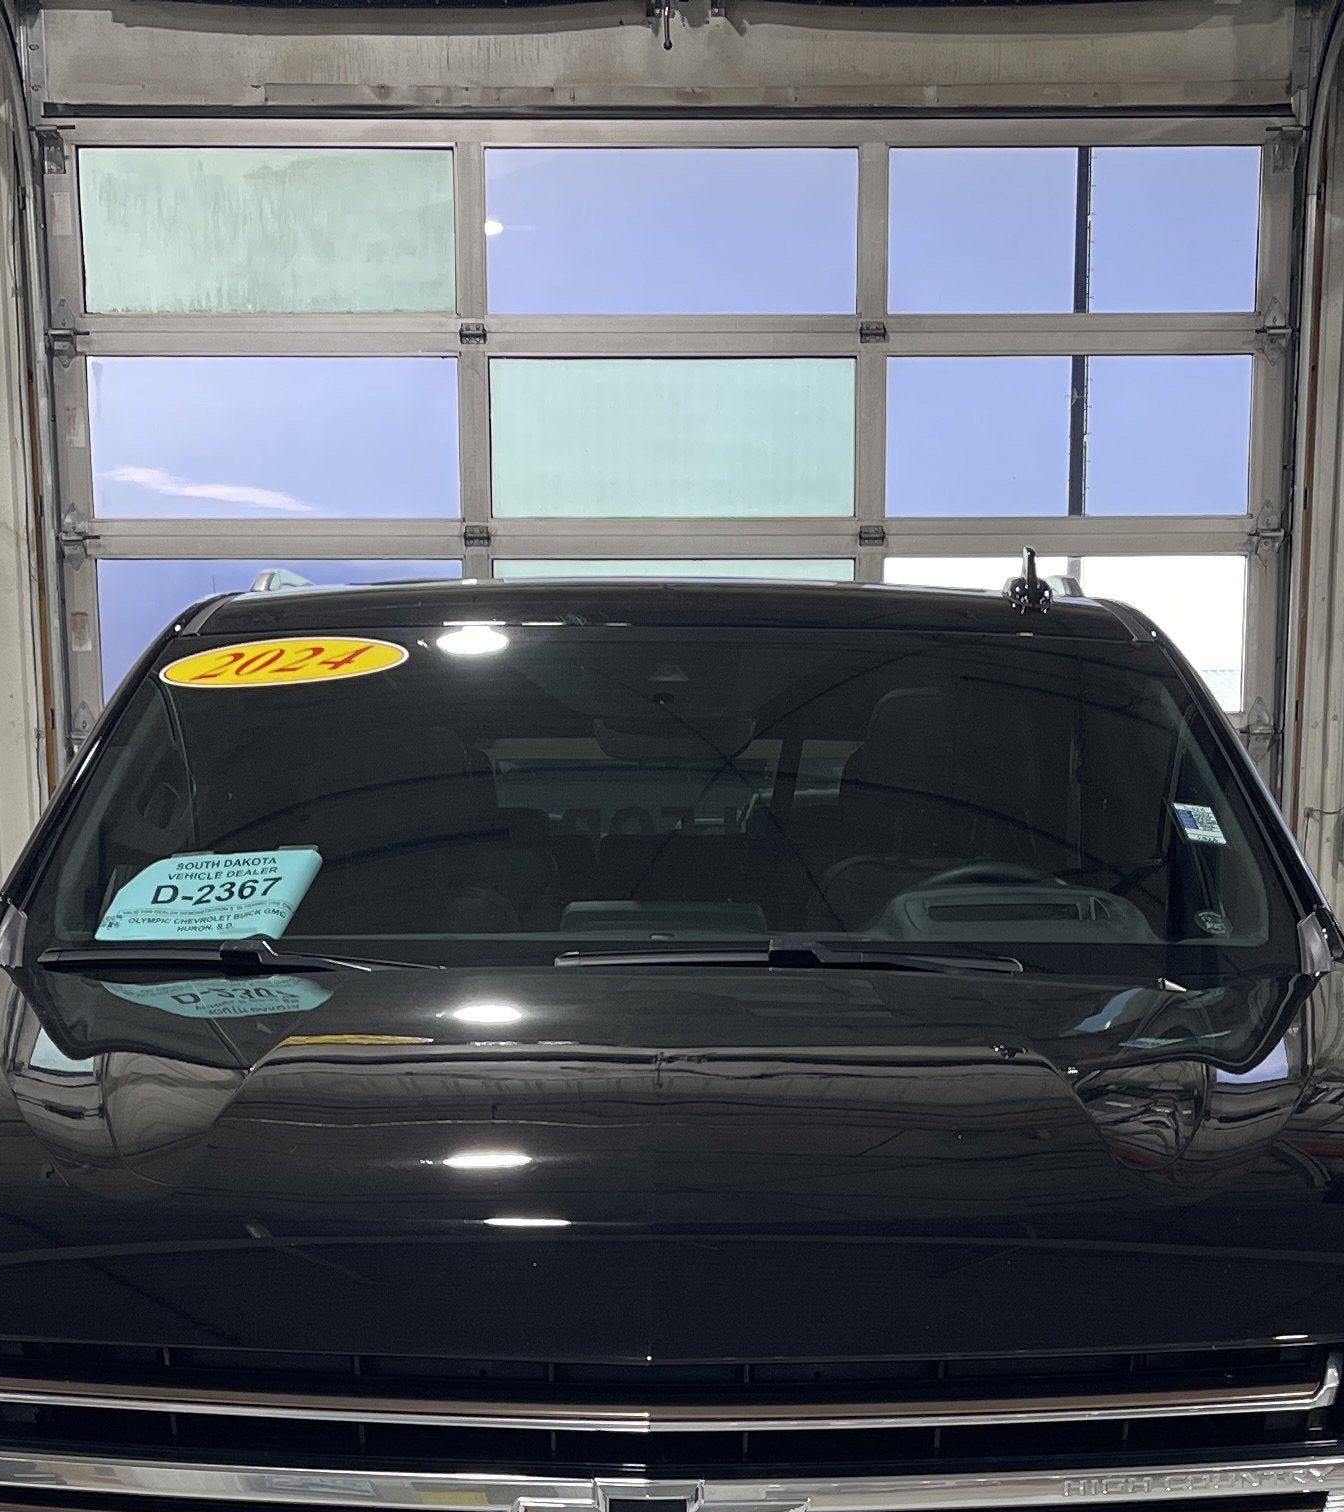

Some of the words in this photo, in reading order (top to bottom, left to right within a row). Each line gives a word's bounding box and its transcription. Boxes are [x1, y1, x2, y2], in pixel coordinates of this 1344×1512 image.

[189, 645, 376, 681] 2024
[167, 871, 223, 881] VEHICLE
[226, 866, 278, 878] DEALER
[176, 860, 221, 870] SOUTH
[223, 856, 277, 868] DAKOTA
[151, 877, 283, 906] D-2367
[173, 914, 231, 925] CHEVROLET
[264, 908, 287, 918] GMC
[1064, 1476, 1152, 1496] HIGH
[1164, 1466, 1335, 1492] COUNTRY
